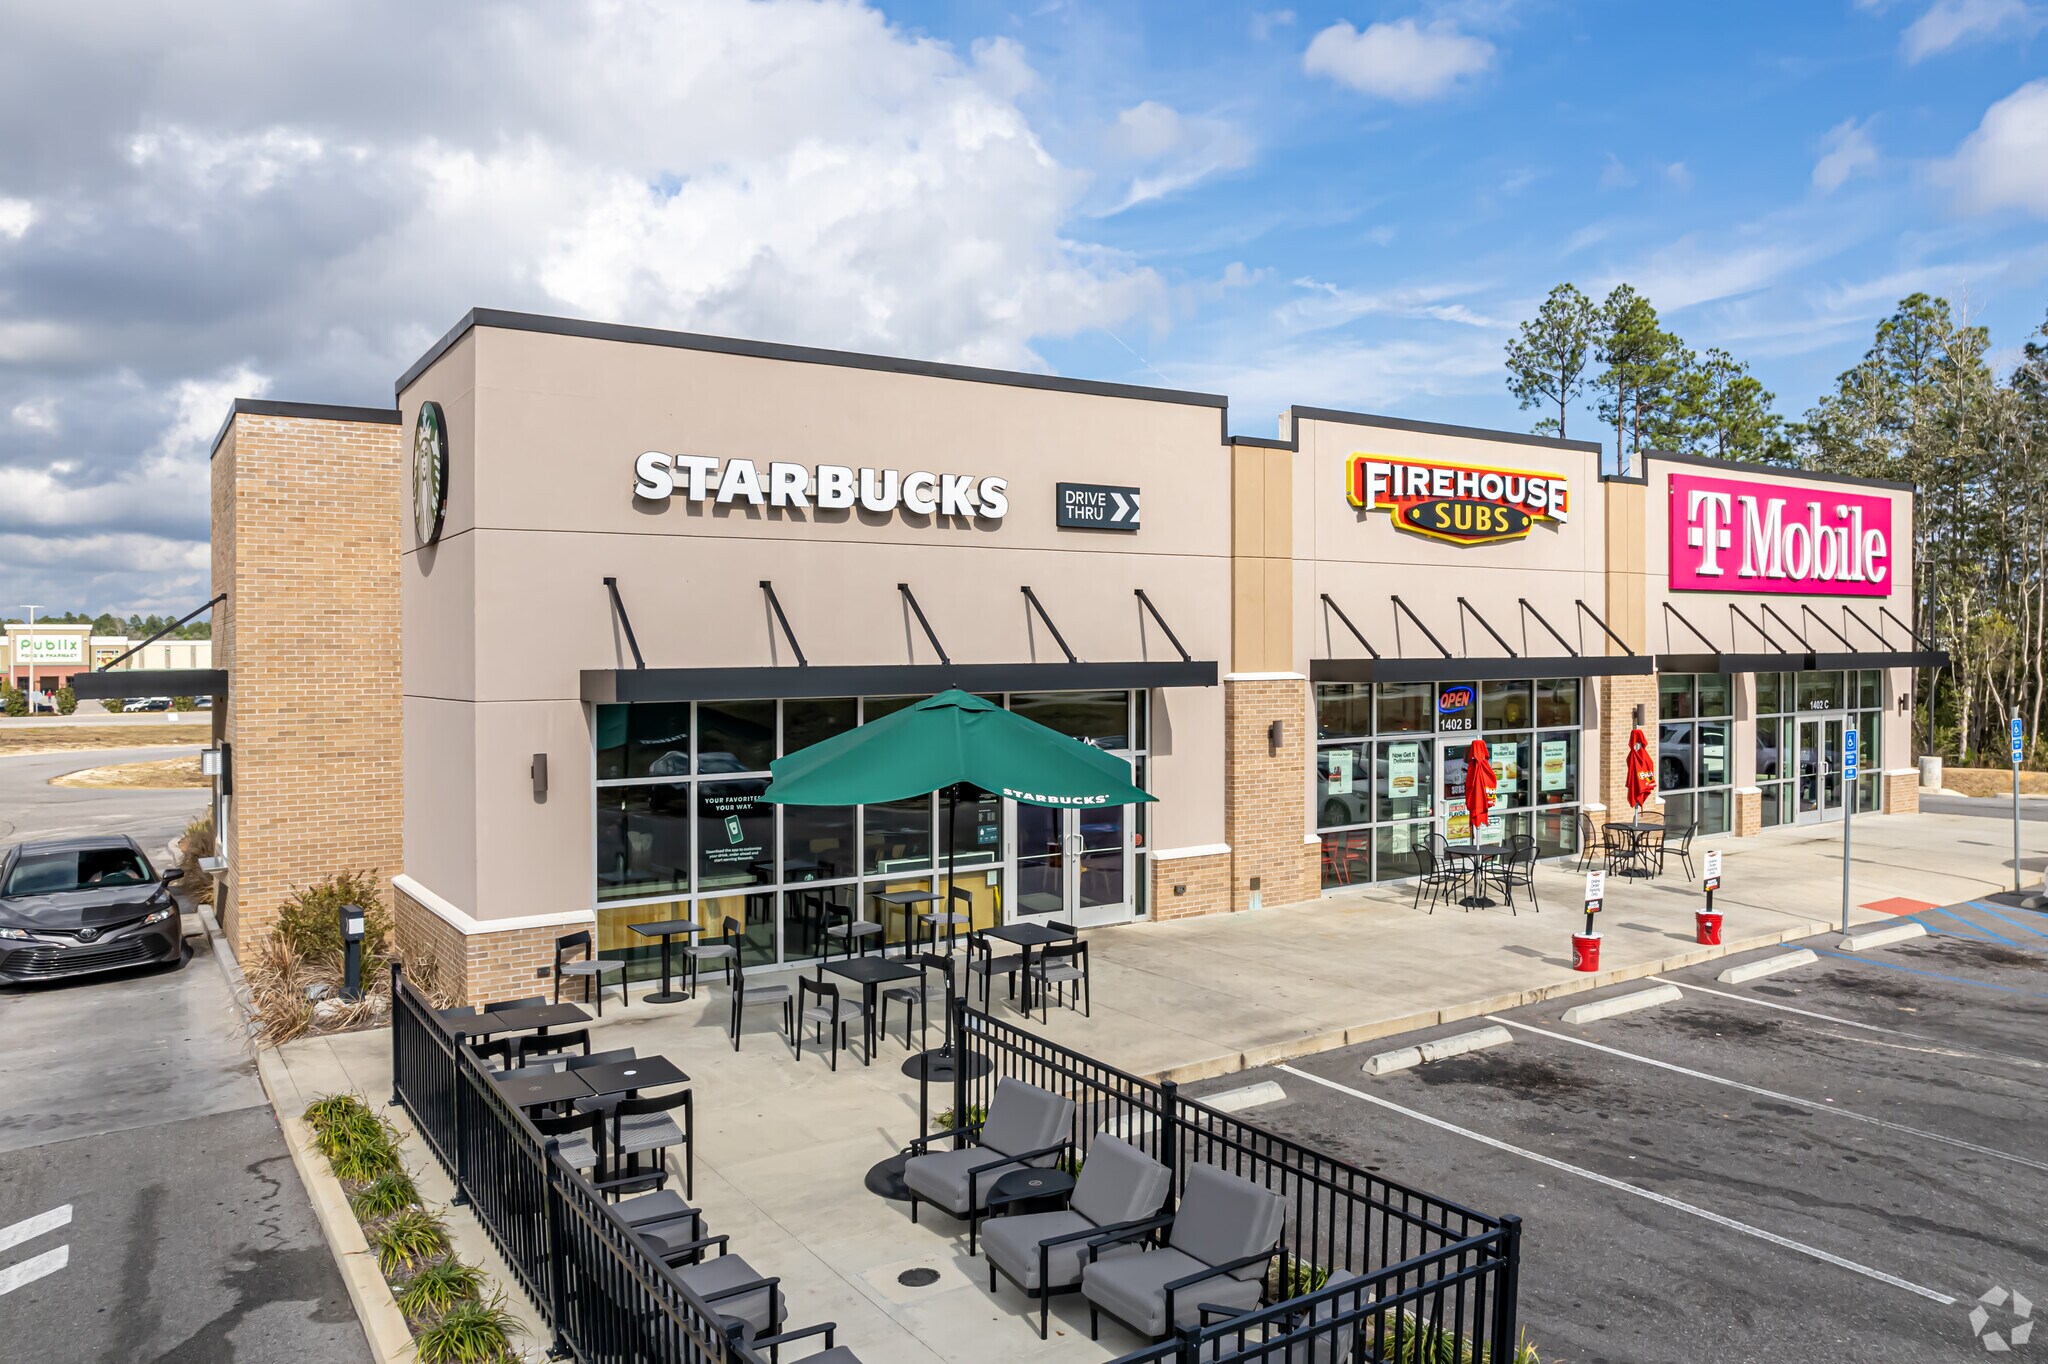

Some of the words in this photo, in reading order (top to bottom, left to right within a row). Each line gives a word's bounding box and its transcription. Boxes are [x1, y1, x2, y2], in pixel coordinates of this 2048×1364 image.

[633, 451, 1009, 519] STARBUCKS
[1364, 461, 1568, 524] FIREHOUSE
[1065, 490, 1106, 506] DRIVE
[1065, 505, 1104, 520] THRU
[1435, 502, 1509, 532] SUBS
[20, 639, 78, 650] Publix
[1440, 691, 1470, 708] OPEN
[1824, 699, 1830, 709] C
[1440, 718, 1462, 731] 1402
[1464, 718, 1472, 730] B
[1003, 788, 1107, 805] STARBUCKS
